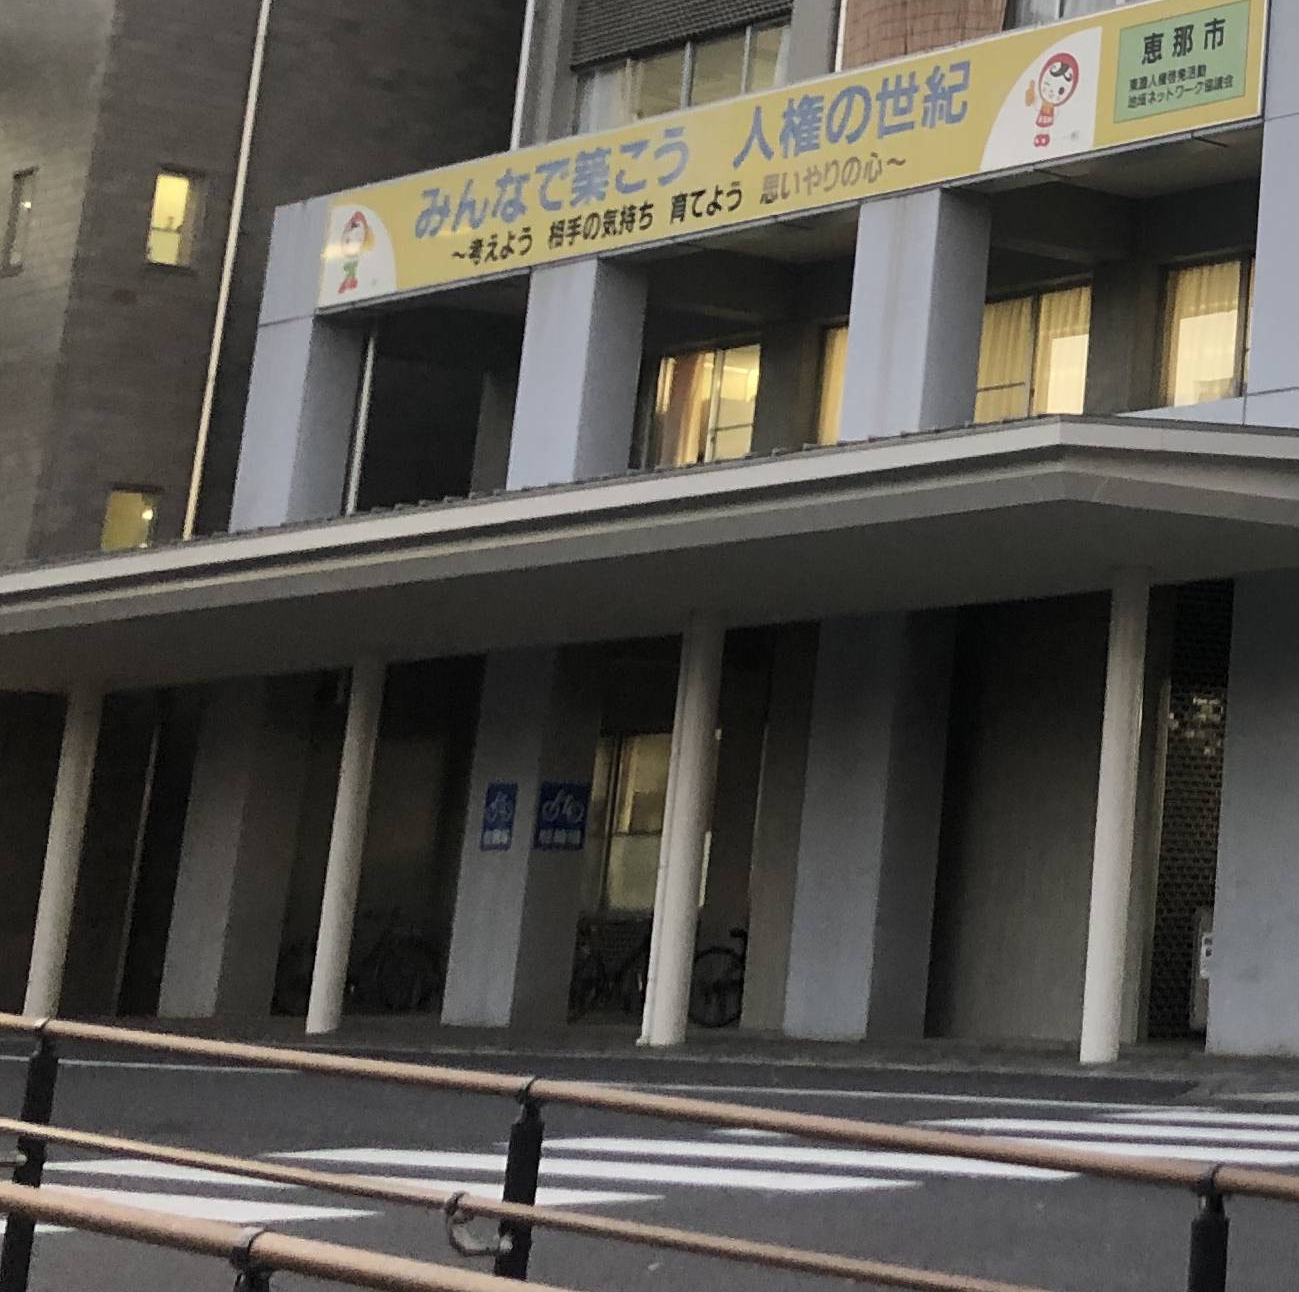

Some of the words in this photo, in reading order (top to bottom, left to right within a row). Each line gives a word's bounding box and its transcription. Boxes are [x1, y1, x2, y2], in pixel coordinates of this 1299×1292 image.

[1141, 17, 1226, 66] 恵那市
[414, 126, 690, 240] みんなで築こう
[732, 59, 972, 170] 人権の世紀
[547, 201, 655, 250] 相手の気持ち
[669, 181, 743, 225] 育てよう
